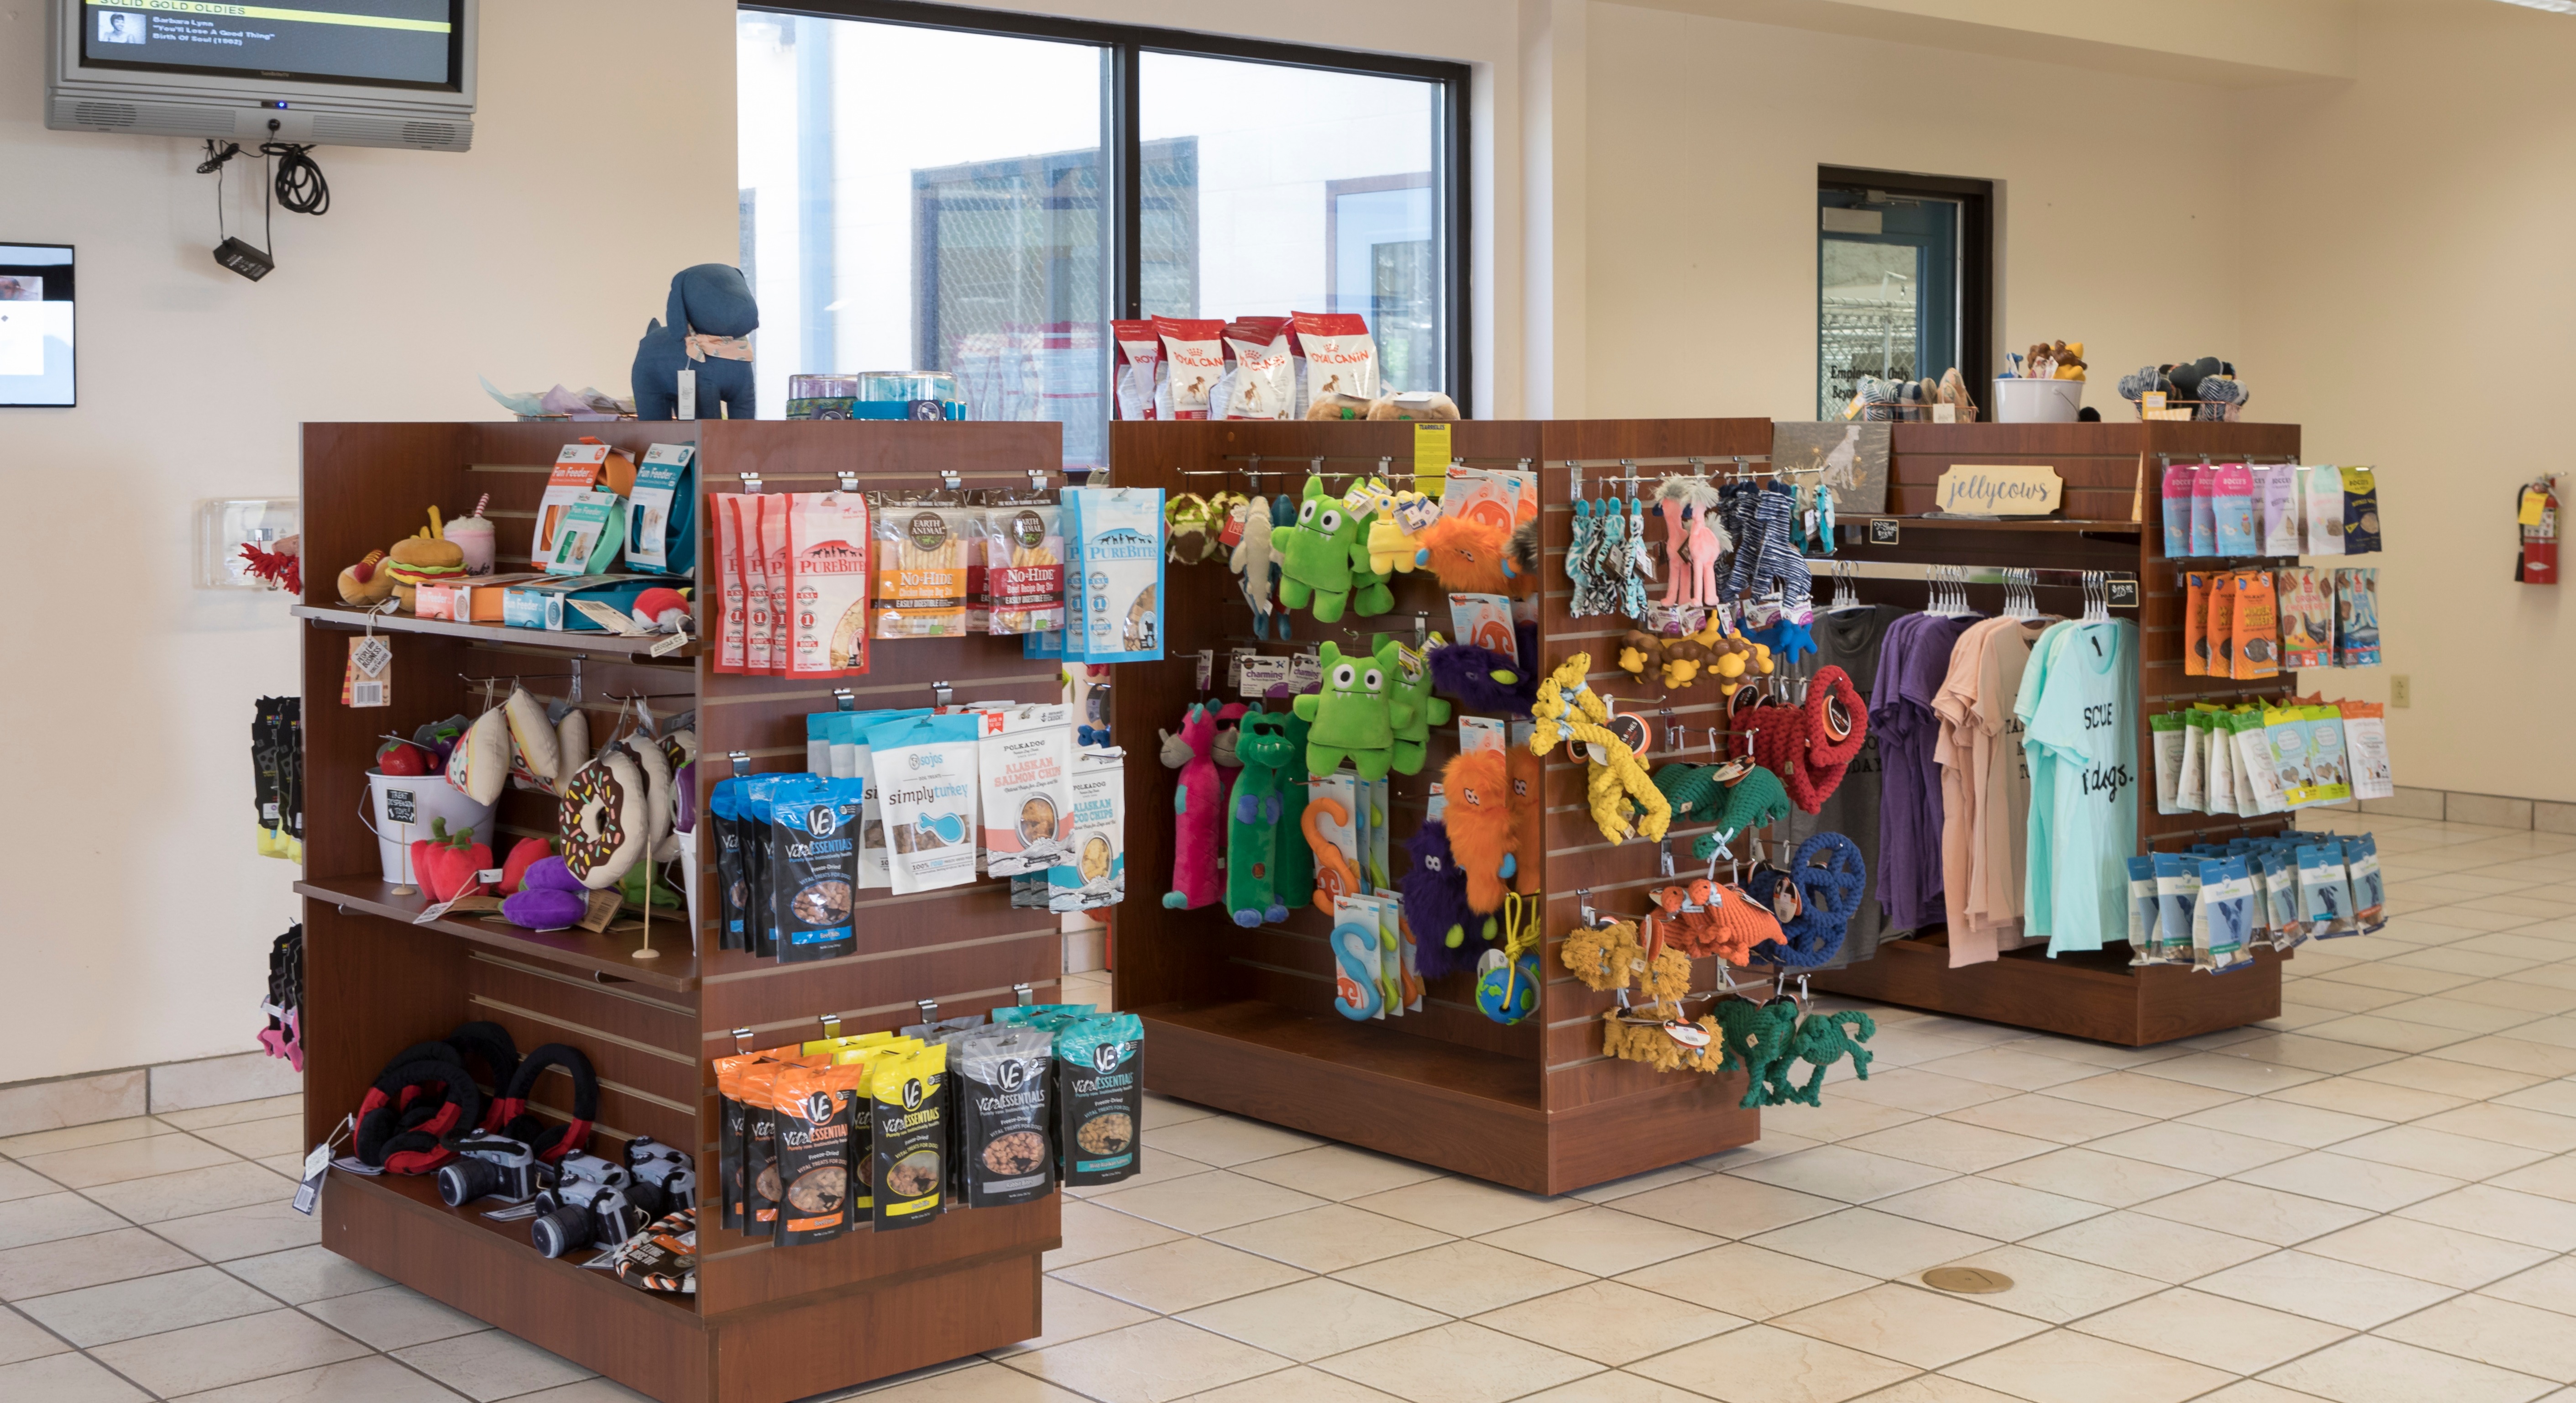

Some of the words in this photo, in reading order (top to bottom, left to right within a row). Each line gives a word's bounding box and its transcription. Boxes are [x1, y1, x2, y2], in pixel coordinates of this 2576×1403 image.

[150, 0, 188, 10] GOLD
[194, 4, 246, 15] OLDIES
[152, 16, 189, 26] Barbara
[191, 19, 214, 27] Lynn
[1134, 355, 1156, 364] ROY
[1199, 357, 1224, 367] CAN
[1888, 367, 1909, 381] Only
[1833, 385, 1857, 402] Beyo
[552, 467, 565, 477] Fun
[565, 467, 590, 477] Feeder
[638, 466, 650, 477] Fun
[650, 467, 671, 479] Feeder
[1947, 475, 2050, 509] jellycows
[571, 505, 585, 514] Fun
[585, 507, 602, 516] Feeder
[913, 519, 941, 527] EARTH
[899, 588, 918, 597] Chicken
[935, 587, 943, 598] Dog
[1007, 584, 1019, 594] Beef
[1037, 583, 1045, 592] Dog
[429, 592, 447, 604] Feeder
[896, 599, 913, 608] EASILY
[1005, 595, 1021, 604] EASILY
[1097, 599, 1104, 608] 1
[517, 600, 538, 611] Feeder
[733, 611, 740, 621] 1
[756, 612, 763, 623] 1
[805, 615, 811, 626] 1
[1246, 670, 1283, 681] charming
[921, 752, 943, 767] sojos
[1005, 757, 1054, 774] ALASKAN
[994, 770, 1036, 788] SALMON
[1074, 799, 1112, 813] ALASKAN
[1074, 812, 1089, 823] COD
[1089, 809, 1113, 821] CHIPS
[809, 809, 836, 835] VE
[913, 862, 929, 870] 100%
[1096, 1046, 1115, 1072] VE
[1000, 1062, 1020, 1089] VE
[904, 1081, 920, 1109] VE
[810, 1094, 830, 1122] VE
[990, 1128, 1003, 1137] VITAL
[808, 1150, 839, 1161] Freeze-Dried
[797, 1164, 811, 1173] VITAL
